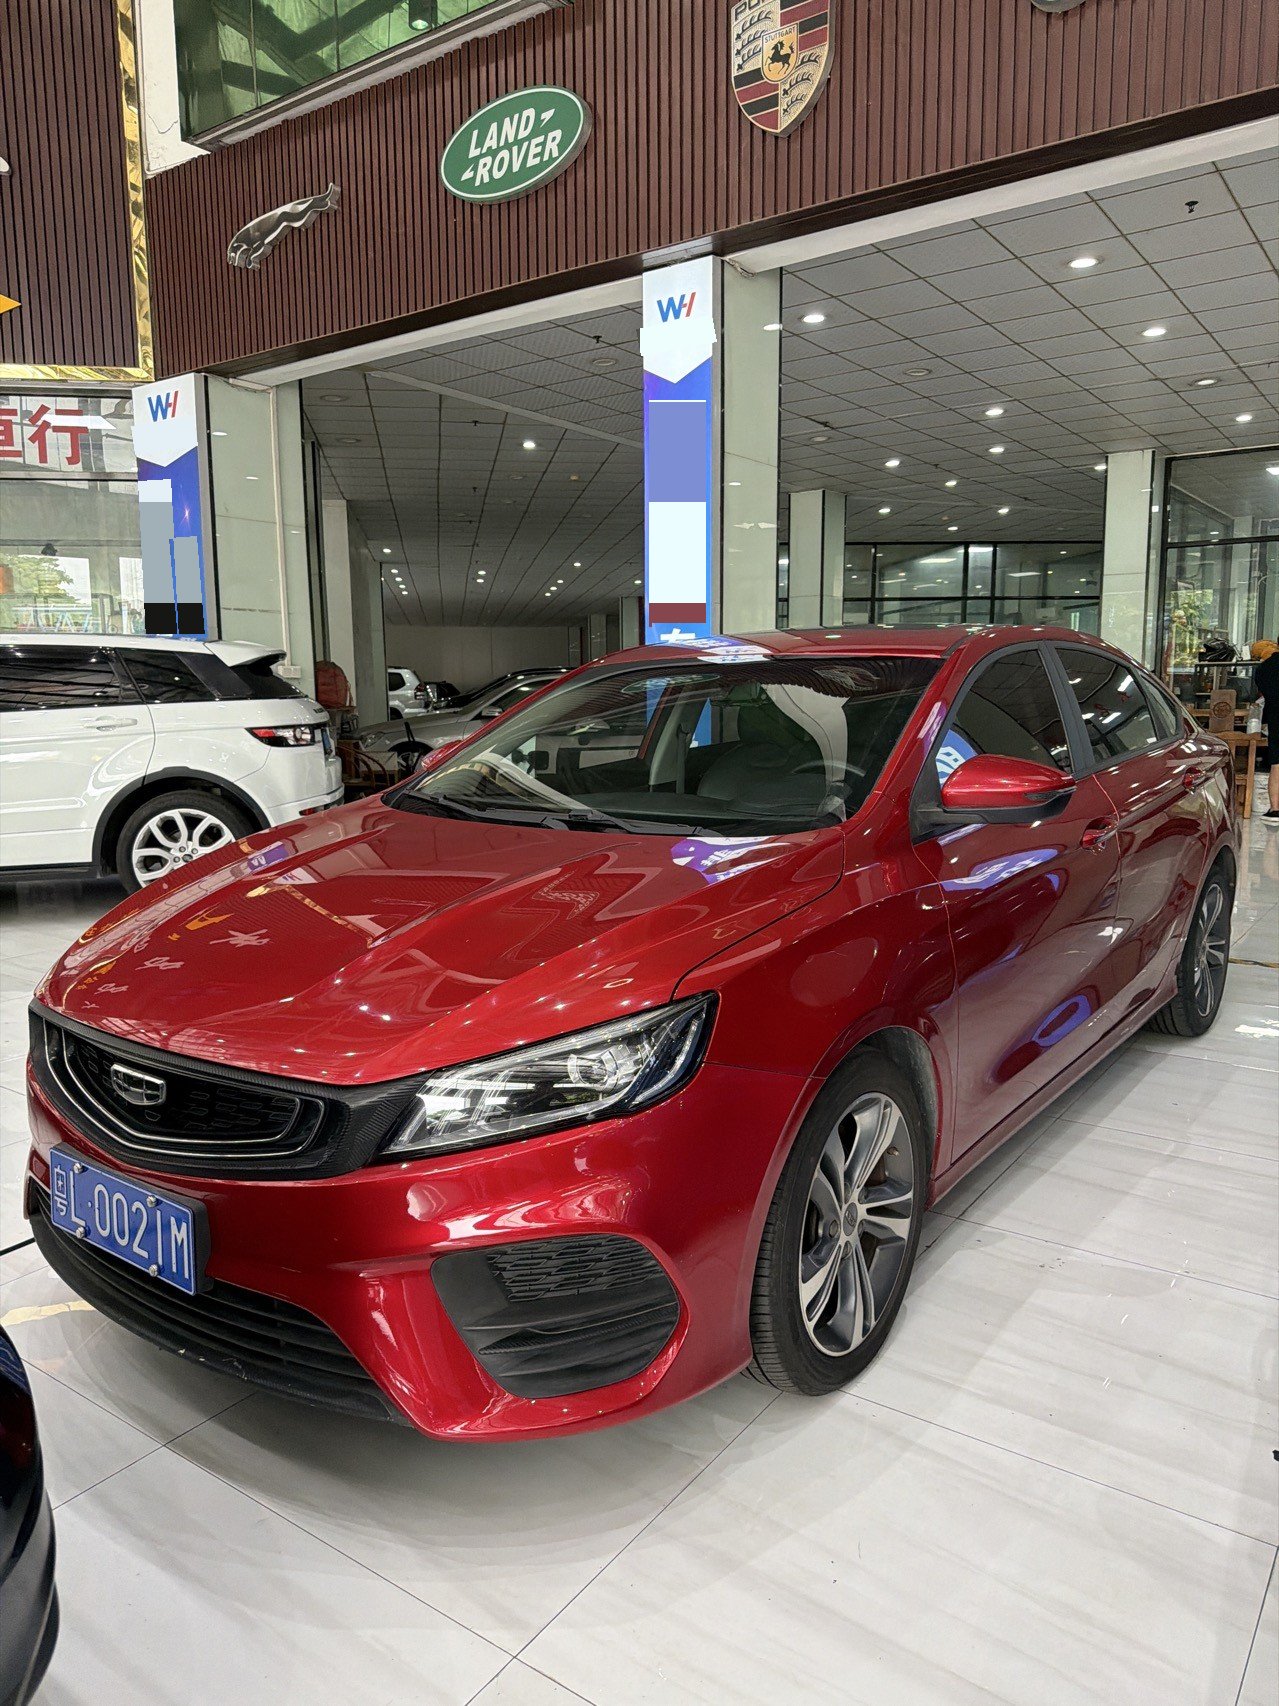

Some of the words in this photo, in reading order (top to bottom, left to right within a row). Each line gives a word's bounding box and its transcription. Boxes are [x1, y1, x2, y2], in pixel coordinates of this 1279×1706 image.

[765, 26, 796, 44] STUTTGART
[468, 107, 536, 158] LAND
[474, 129, 563, 187] ROVER
